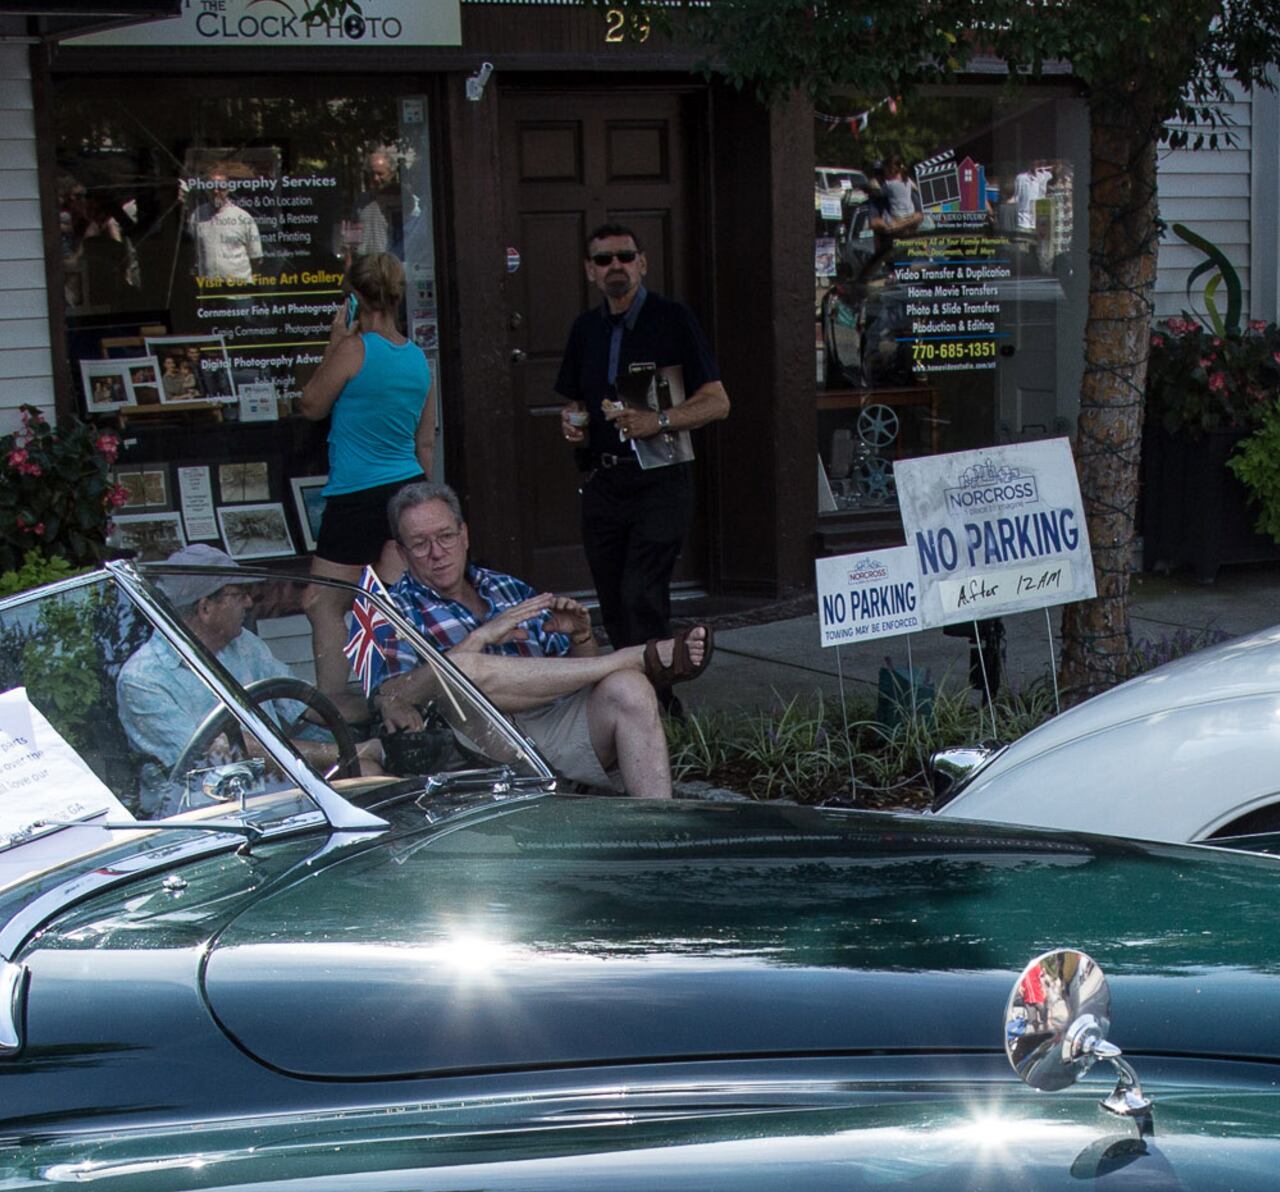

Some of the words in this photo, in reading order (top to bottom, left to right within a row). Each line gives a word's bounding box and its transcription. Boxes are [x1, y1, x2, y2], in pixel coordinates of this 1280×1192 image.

[201, 0, 226, 11] THE
[196, 12, 298, 37] CLOCK
[305, 15, 402, 39] PHOTO
[188, 176, 277, 192] Photography
[282, 174, 336, 188] Services
[262, 196, 275, 207] On
[277, 195, 313, 207] Location
[287, 213, 319, 225] Restore
[278, 231, 312, 244] Printing
[252, 272, 277, 286] Fine
[280, 272, 298, 285] Art
[301, 270, 345, 286] Gallery
[895, 268, 920, 280] Video
[922, 267, 954, 279] Transfer
[956, 267, 963, 278] &
[965, 266, 1011, 280] Duplication
[908, 286, 933, 298] Home
[935, 285, 960, 297] Movie
[962, 283, 998, 296] Transfers
[252, 304, 269, 316] Fine
[272, 305, 286, 315] Art
[906, 303, 931, 316] Photo
[933, 303, 940, 315] &
[941, 302, 962, 315] Slide
[963, 301, 1000, 314] Transfers
[912, 321, 956, 334] Production
[958, 320, 965, 332] &
[967, 319, 995, 333] Editing
[912, 342, 996, 360] 770-685-1351
[201, 356, 231, 371] Digital
[234, 354, 294, 369] Photography
[950, 482, 1034, 509] NORCROSS
[916, 527, 959, 575] NO
[964, 508, 1079, 568] PARKING
[849, 568, 886, 580] NORCROSS
[957, 580, 999, 607] After
[823, 593, 846, 625] NO
[850, 582, 916, 621] PARKING
[825, 628, 854, 640] TOWING
[855, 625, 869, 636] MAY
[871, 623, 880, 633] BE
[0, 736, 29, 753] parts
[3, 757, 23, 769] over
[26, 750, 43, 760] the
[31, 769, 47, 781] our
